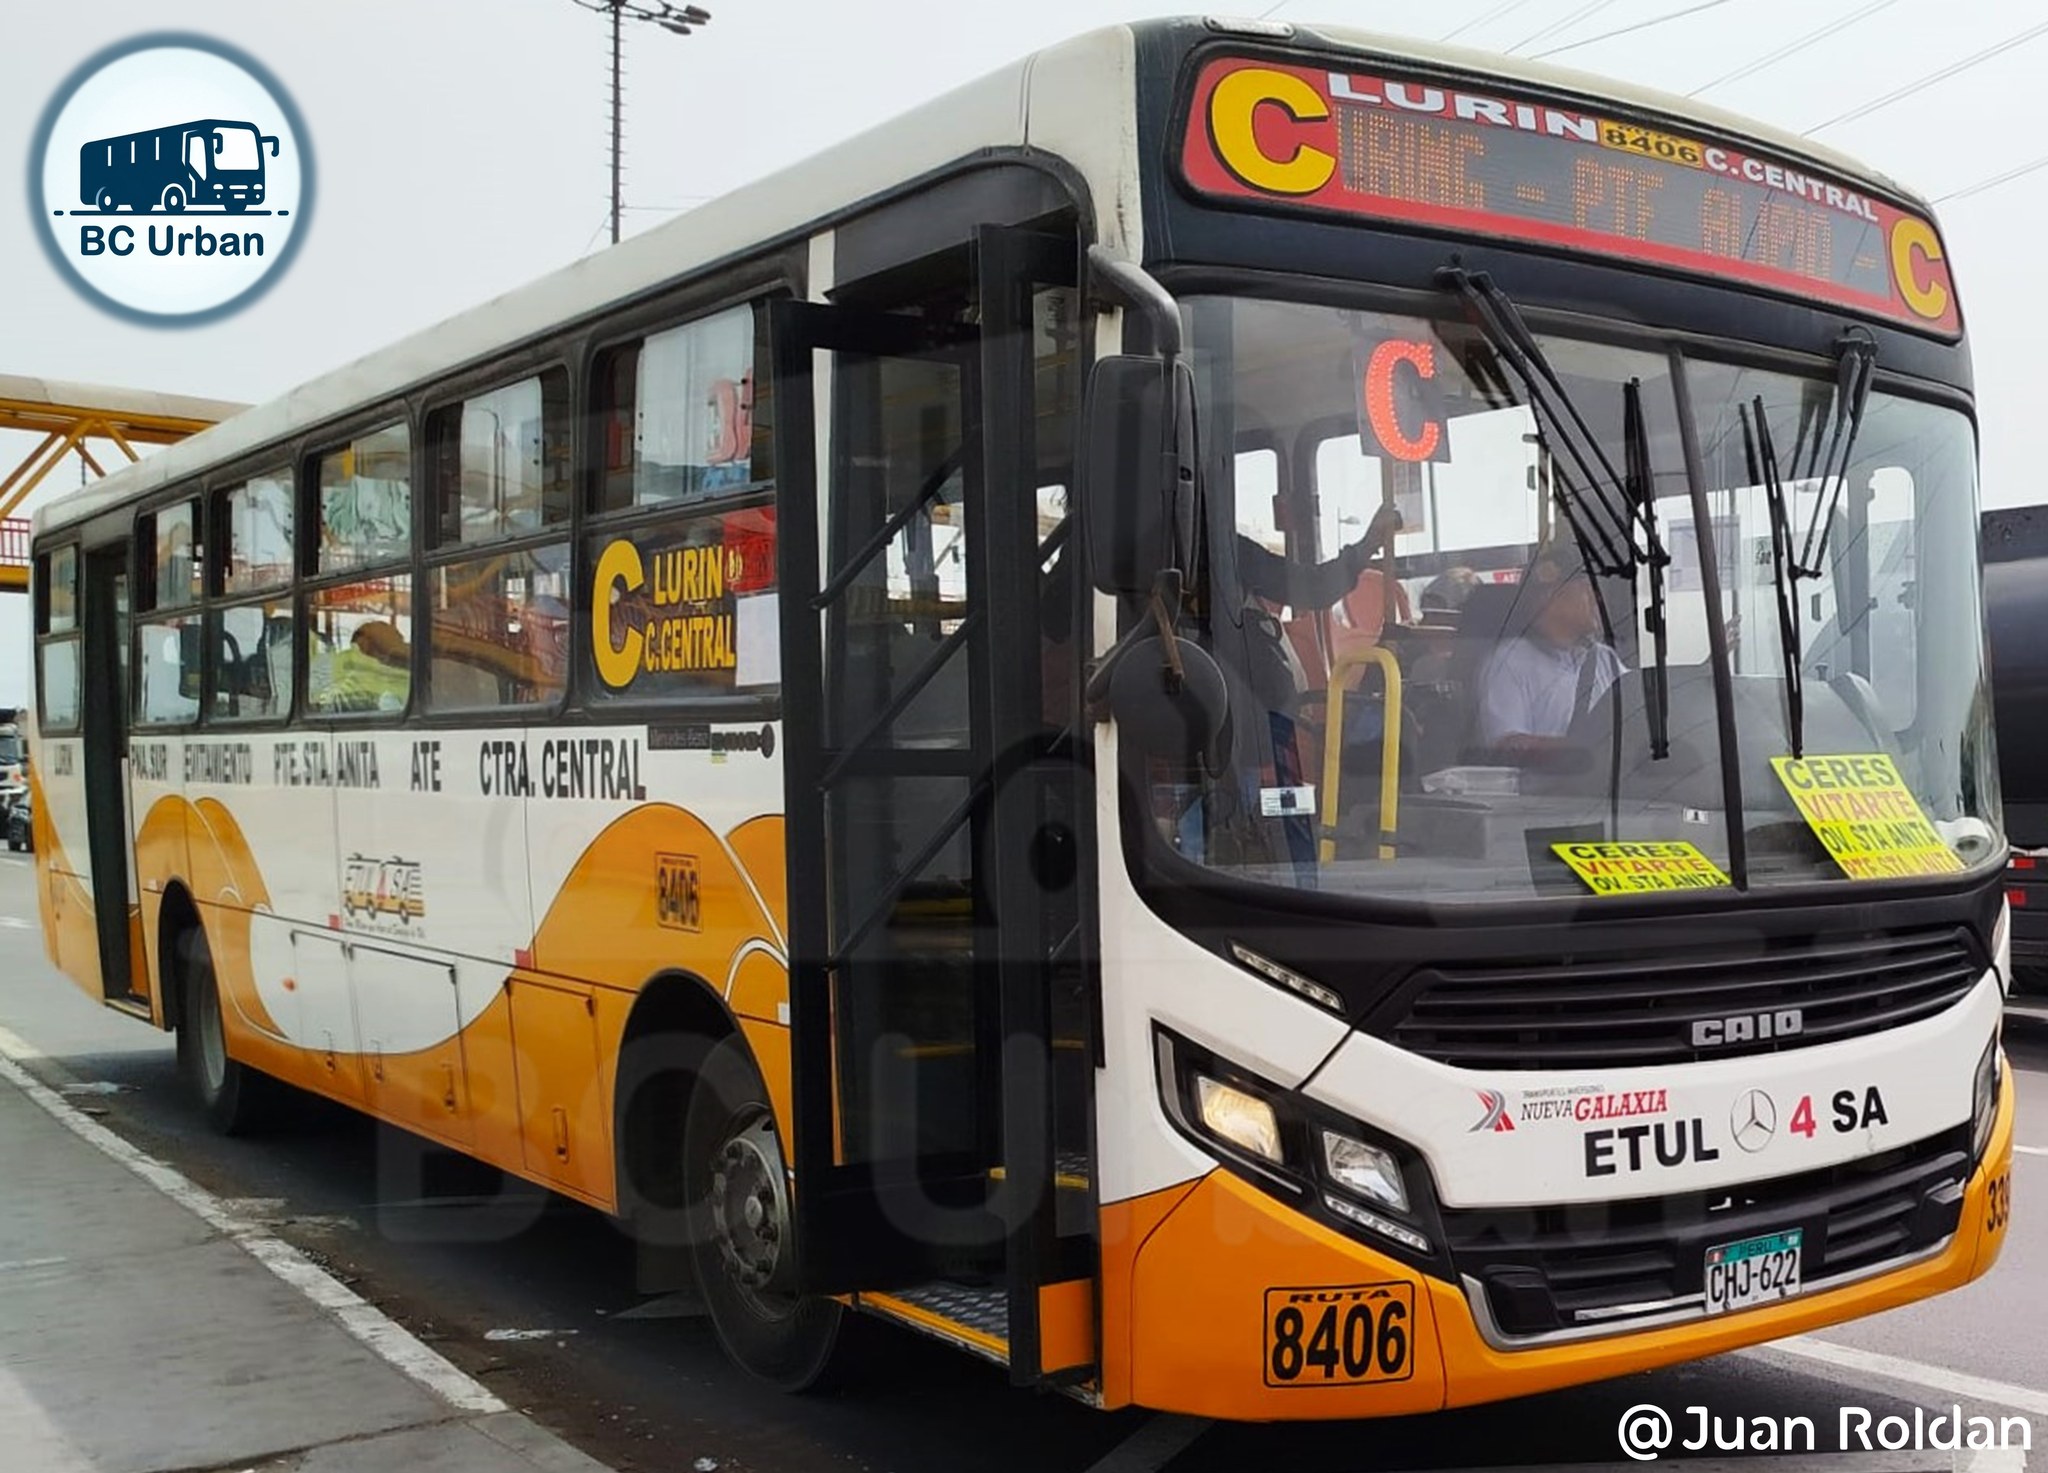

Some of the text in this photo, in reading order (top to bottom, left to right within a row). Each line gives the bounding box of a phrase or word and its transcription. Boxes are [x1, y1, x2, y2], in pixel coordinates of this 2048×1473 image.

[1205, 67, 1337, 197] C
[1327, 73, 1598, 142] LURIN
[1605, 128, 1699, 162] 8406
[1705, 147, 1879, 221] C.CENTRAL
[1891, 218, 1947, 318] C
[1365, 339, 1440, 462] C
[654, 545, 723, 605] LURIN
[593, 539, 644, 687] C
[410, 741, 441, 792] ATE
[480, 740, 537, 798] CTRA.
[542, 739, 648, 801] CENTRAL
[1784, 758, 1895, 789] CERES
[1801, 790, 1917, 823] VITARTE
[1569, 844, 1691, 859] CERES
[1850, 823, 1890, 851] STA
[1885, 822, 1942, 848] ANITA
[1576, 858, 1709, 875] VITARTE
[1628, 873, 1668, 890] STA
[1670, 872, 1726, 888] ANITA
[657, 866, 699, 926] 8406
[1691, 1009, 1803, 1047] CAIO
[1521, 1089, 1668, 1121] NUEVA GALAXIA
[1584, 1085, 1889, 1178] ETUL 4 SA
[1289, 1290, 1391, 1303] RUTA
[1711, 1248, 1796, 1303] CHJ-622
[1272, 1300, 1407, 1380] 8406
